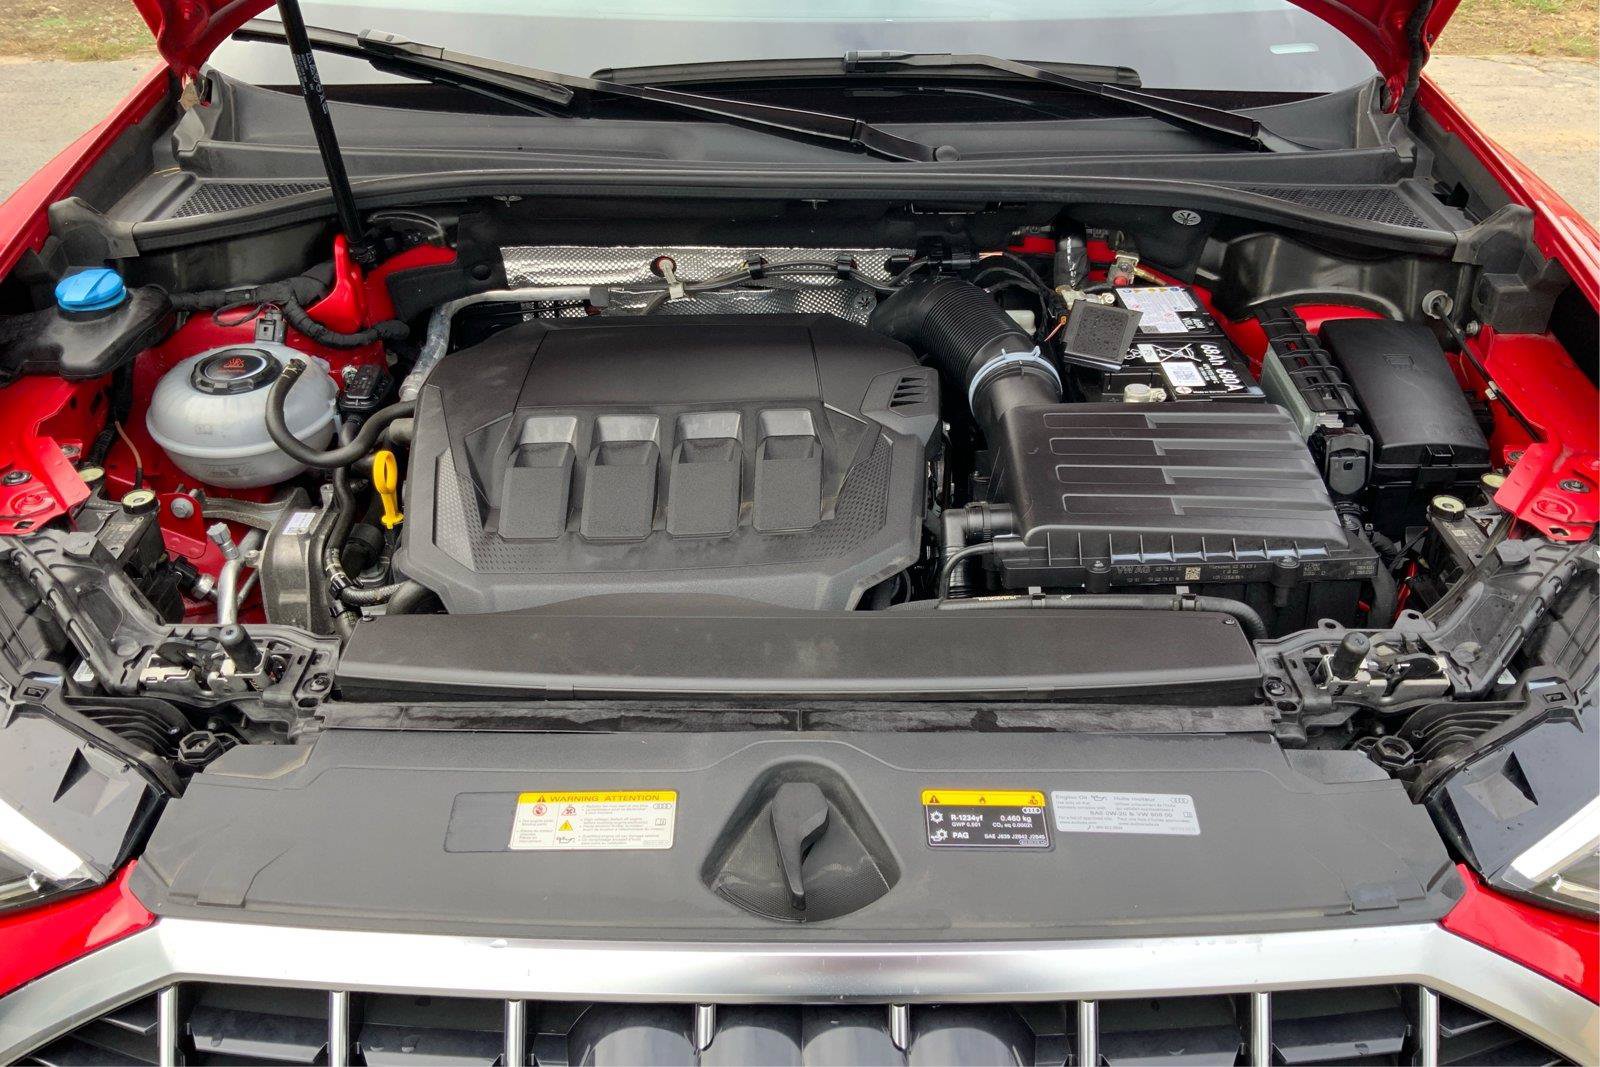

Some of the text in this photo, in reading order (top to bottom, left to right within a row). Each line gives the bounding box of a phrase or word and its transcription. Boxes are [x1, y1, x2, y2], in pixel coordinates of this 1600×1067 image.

[1200, 344, 1227, 366] 68Ah
[1215, 368, 1244, 392] 680A
[550, 794, 660, 803] WARNING ATTENTION
[950, 814, 983, 823] R-1234yf
[1022, 815, 1032, 823] kg
[952, 832, 970, 840] PAG
